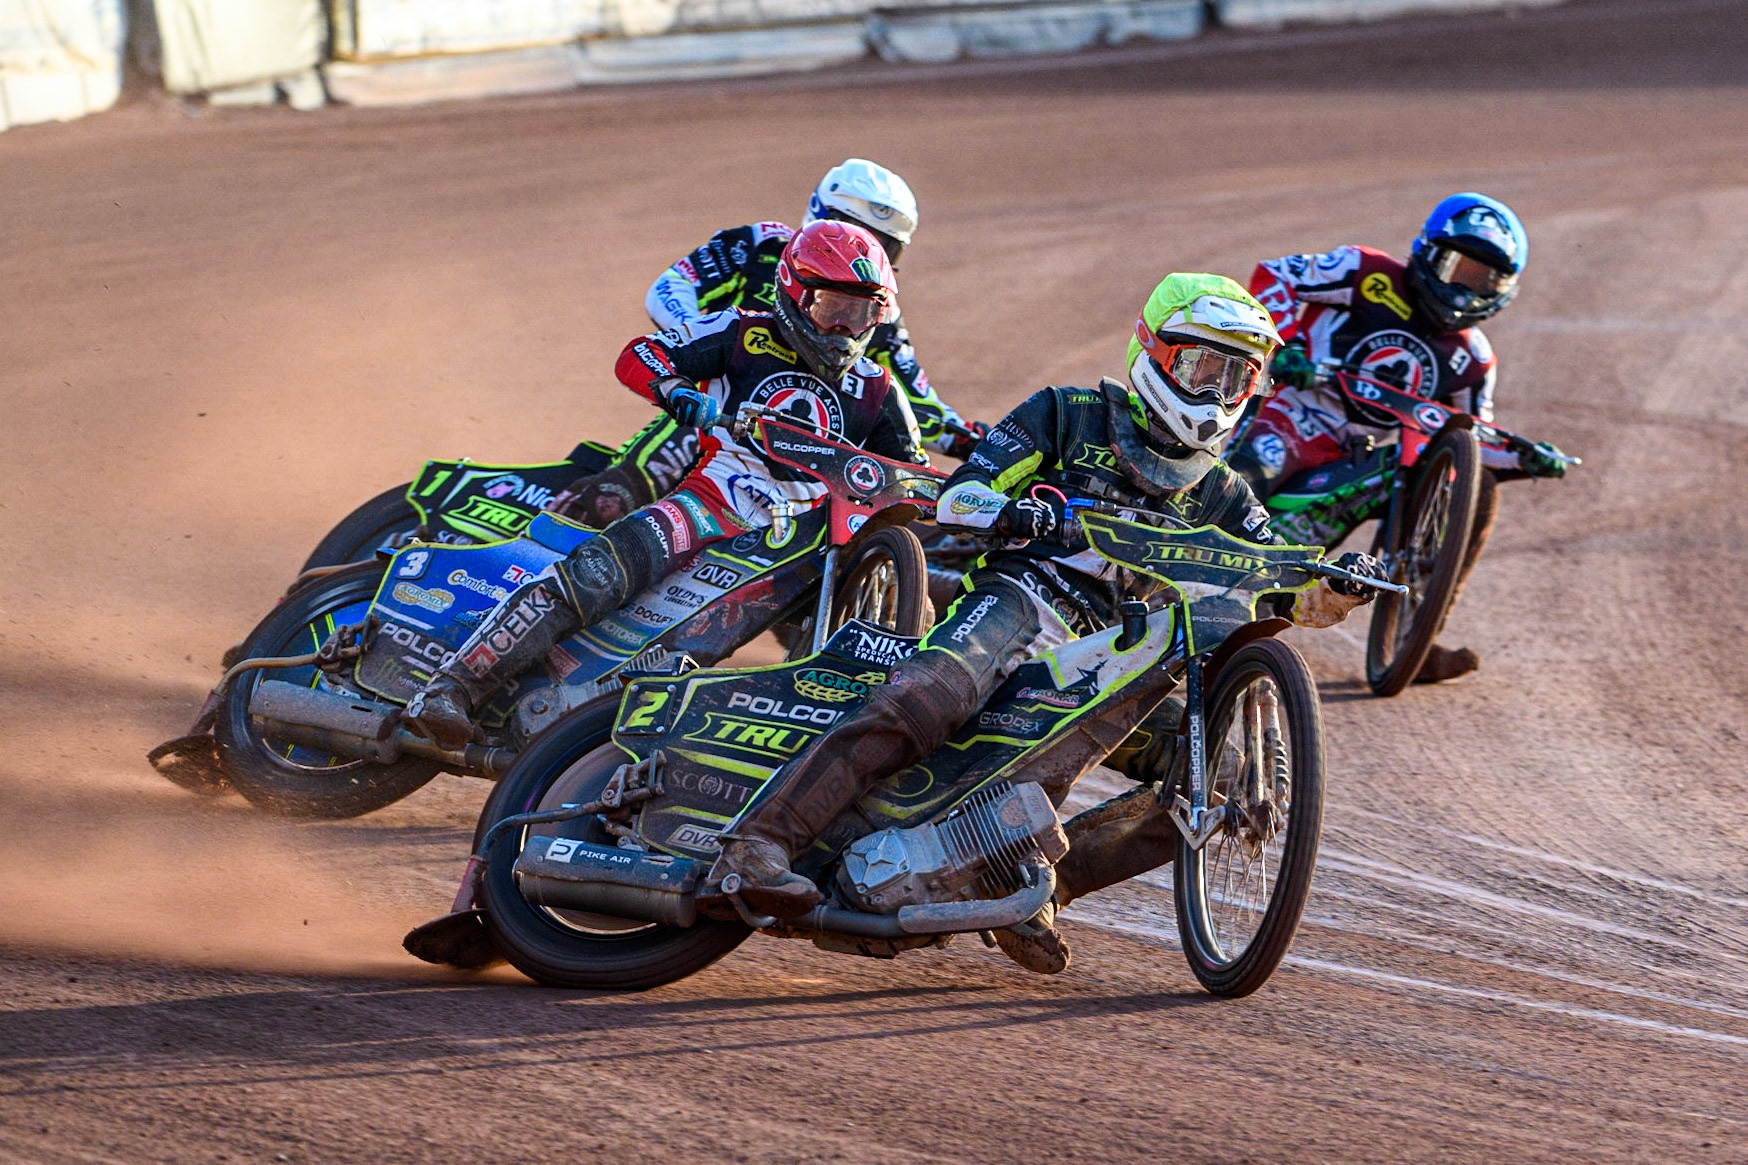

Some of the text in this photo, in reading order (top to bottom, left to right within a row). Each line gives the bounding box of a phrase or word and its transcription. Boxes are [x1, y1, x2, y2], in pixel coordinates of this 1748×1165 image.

[846, 373, 860, 396] 3
[760, 377, 841, 429] BELLE VUE ACES
[773, 441, 836, 456] POLCOPPER
[420, 470, 452, 496] 1
[646, 515, 670, 559] DOCUFY
[400, 551, 429, 577] 3
[1159, 545, 1214, 562] TRU
[696, 565, 738, 588] DVR
[635, 606, 675, 624] DOCUFY
[856, 645, 897, 661] SPEDYCJA
[802, 670, 868, 696] AGRO
[625, 691, 669, 727] 2
[727, 692, 844, 725] POLCO
[979, 711, 1040, 733] GRODEX
[713, 720, 811, 753] TRU
[1190, 714, 1202, 792] POLCOPPER
[671, 770, 754, 803] SCOTT
[677, 829, 718, 847] DVR
[579, 849, 632, 865] PIKE AIR
